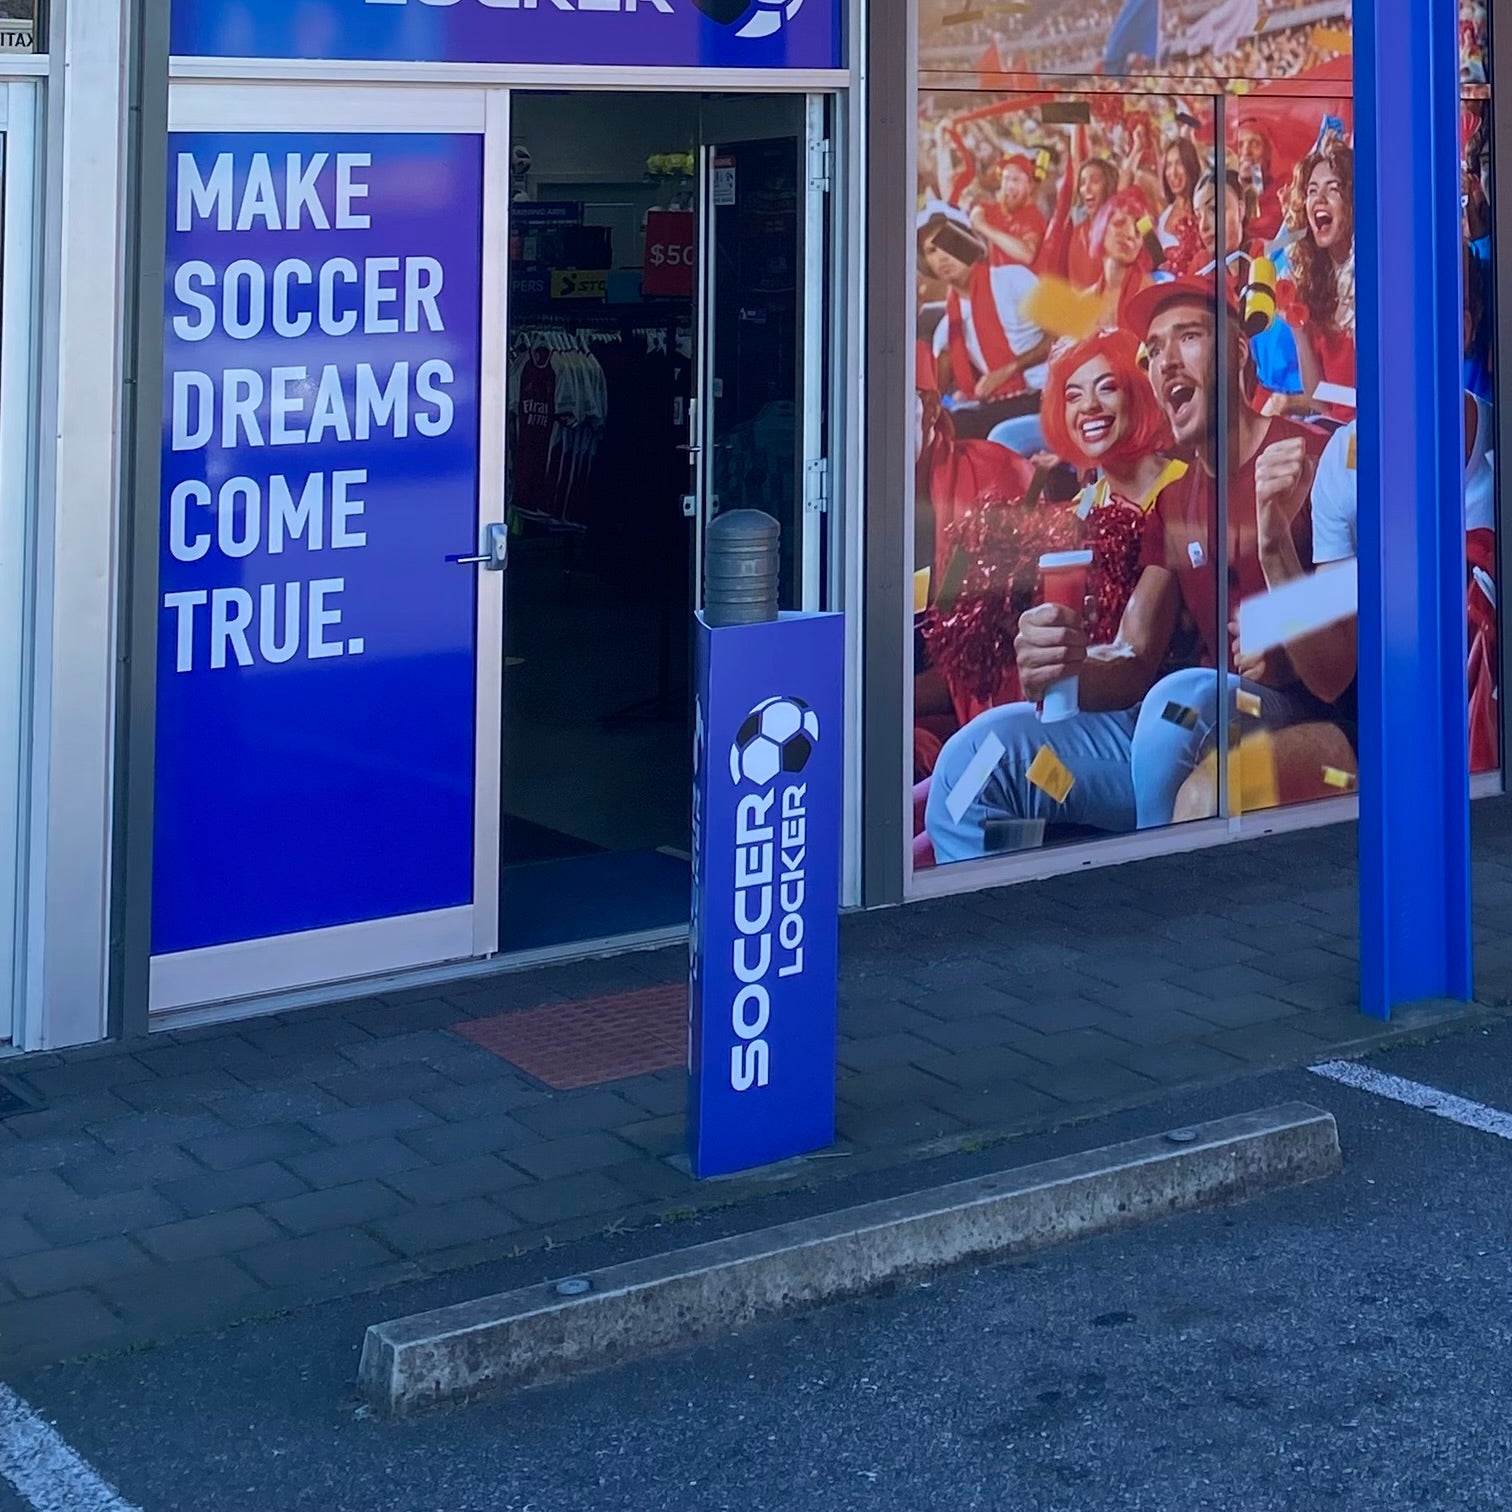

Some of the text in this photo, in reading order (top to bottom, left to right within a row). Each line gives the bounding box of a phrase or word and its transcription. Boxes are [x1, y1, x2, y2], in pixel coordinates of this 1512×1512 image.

[176, 152, 371, 232] MAKE
[172, 256, 445, 342] SOCCER
[171, 359, 455, 452] DREAMS
[169, 469, 368, 562] COME
[164, 578, 365, 672] TRUE.
[777, 781, 807, 978] LOCKER
[731, 786, 774, 1092] SOCCER
